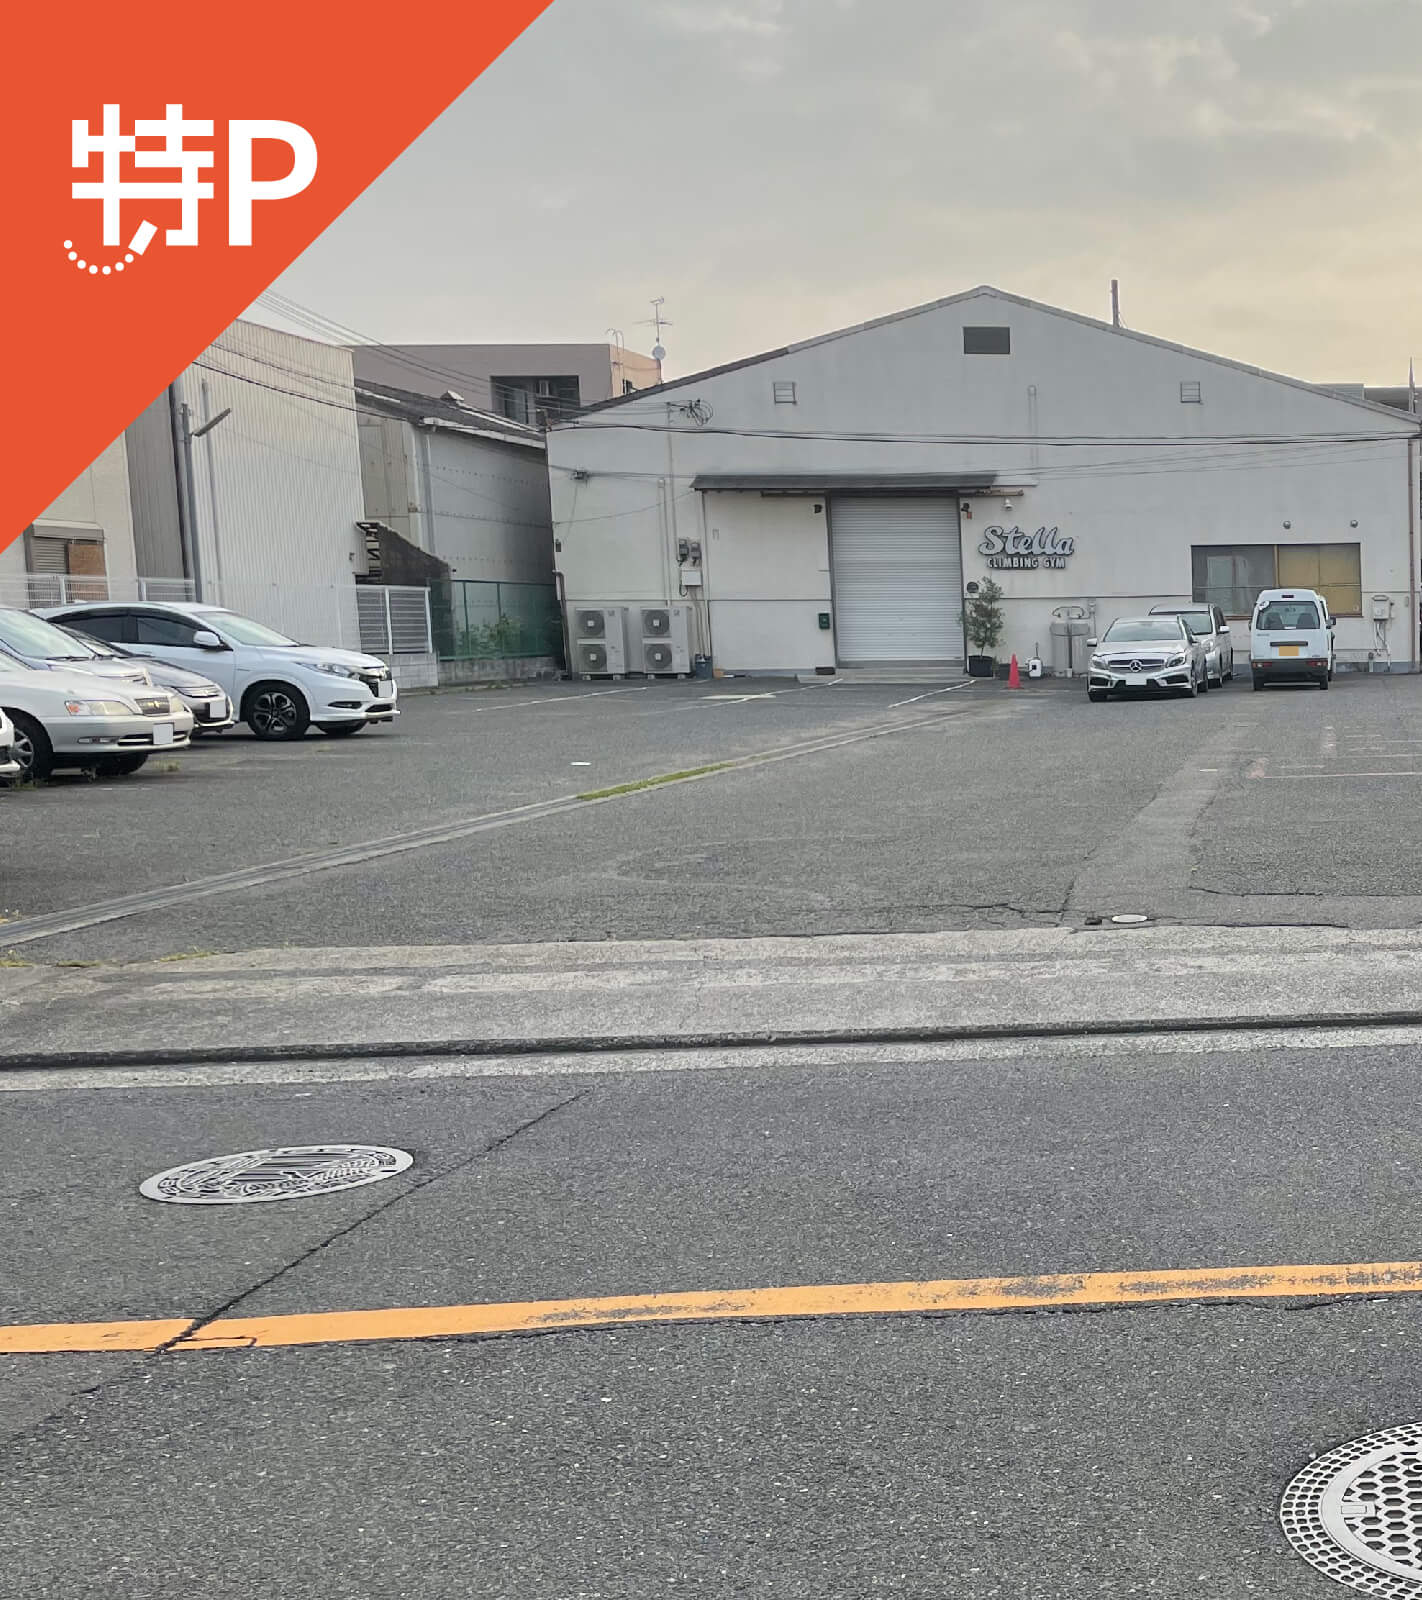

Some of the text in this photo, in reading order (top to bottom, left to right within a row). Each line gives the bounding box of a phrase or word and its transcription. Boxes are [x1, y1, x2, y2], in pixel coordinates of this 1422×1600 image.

[978, 525, 1074, 556] Stella
[986, 557, 1066, 569] CLIMBING GYM
